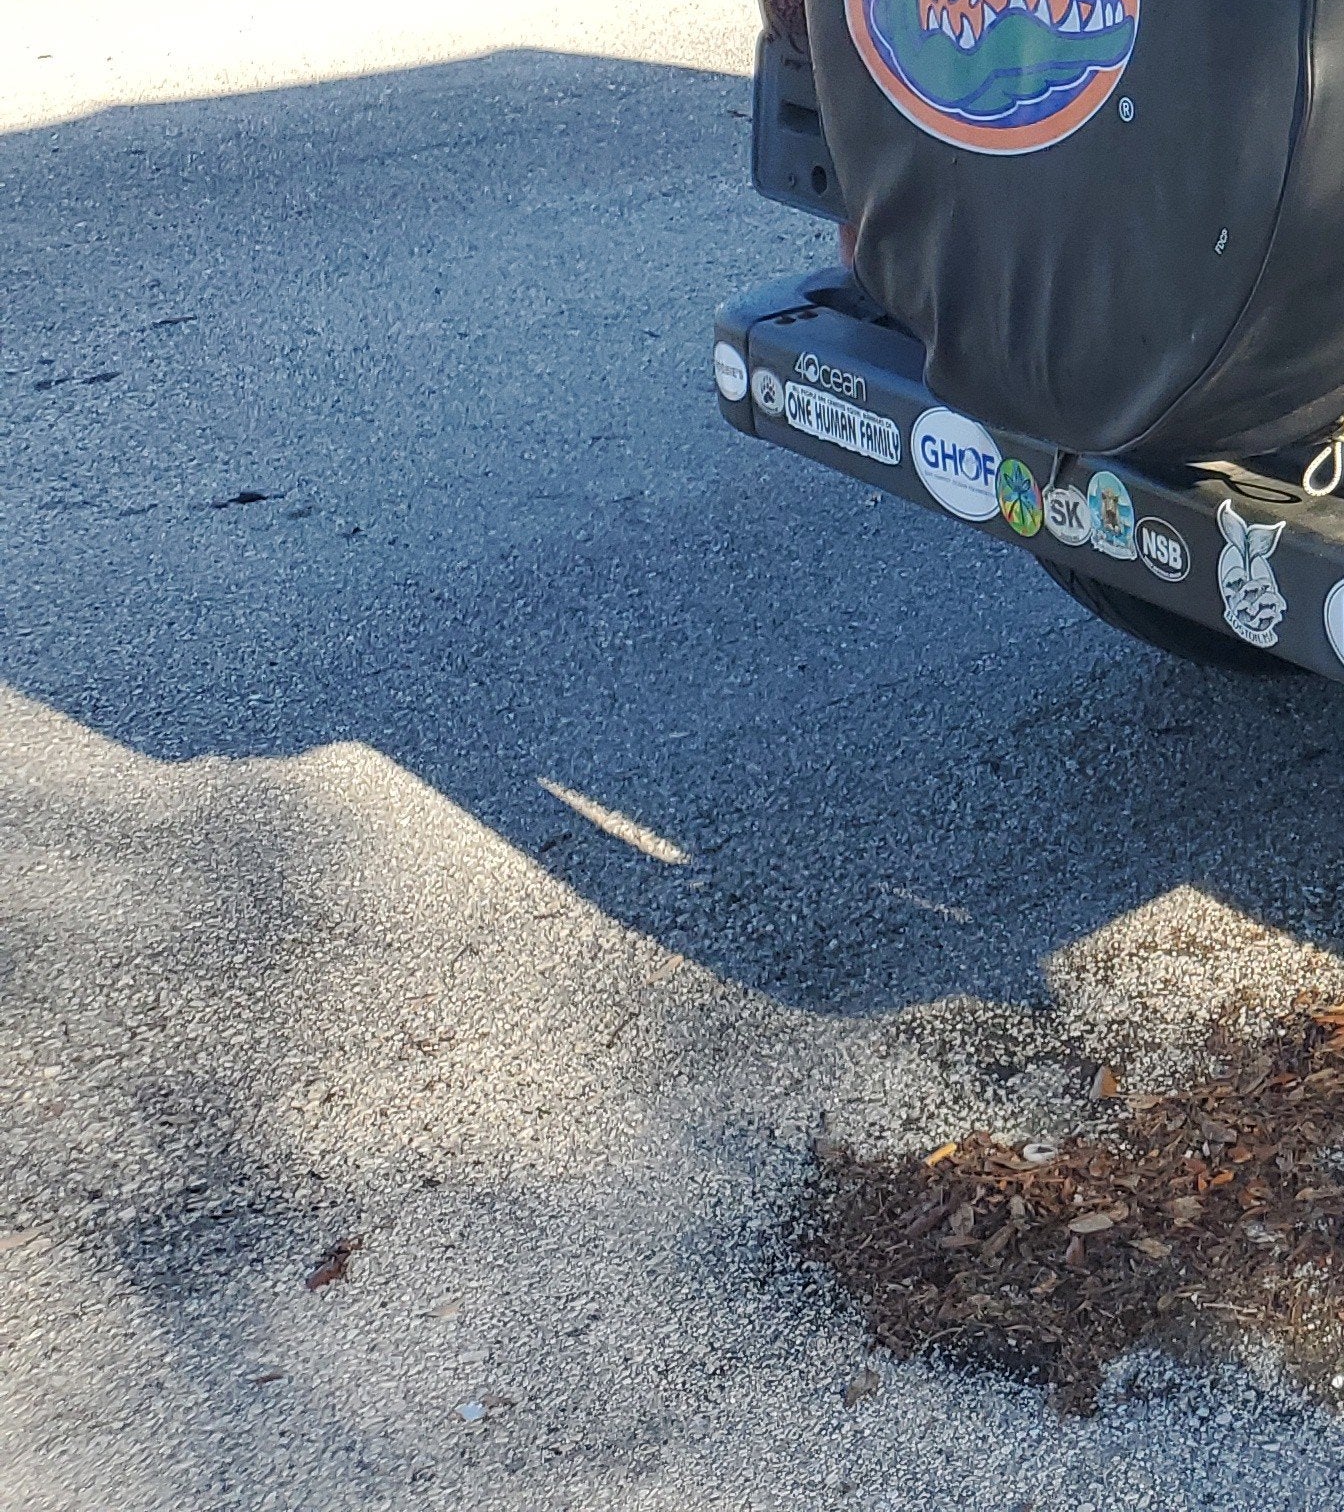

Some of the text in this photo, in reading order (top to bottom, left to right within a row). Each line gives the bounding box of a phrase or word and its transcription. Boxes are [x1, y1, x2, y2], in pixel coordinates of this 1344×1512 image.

[787, 392, 900, 462] ONE HUMAN FAMILY
[1050, 499, 1085, 530] SK
[1142, 526, 1183, 570] NSB
